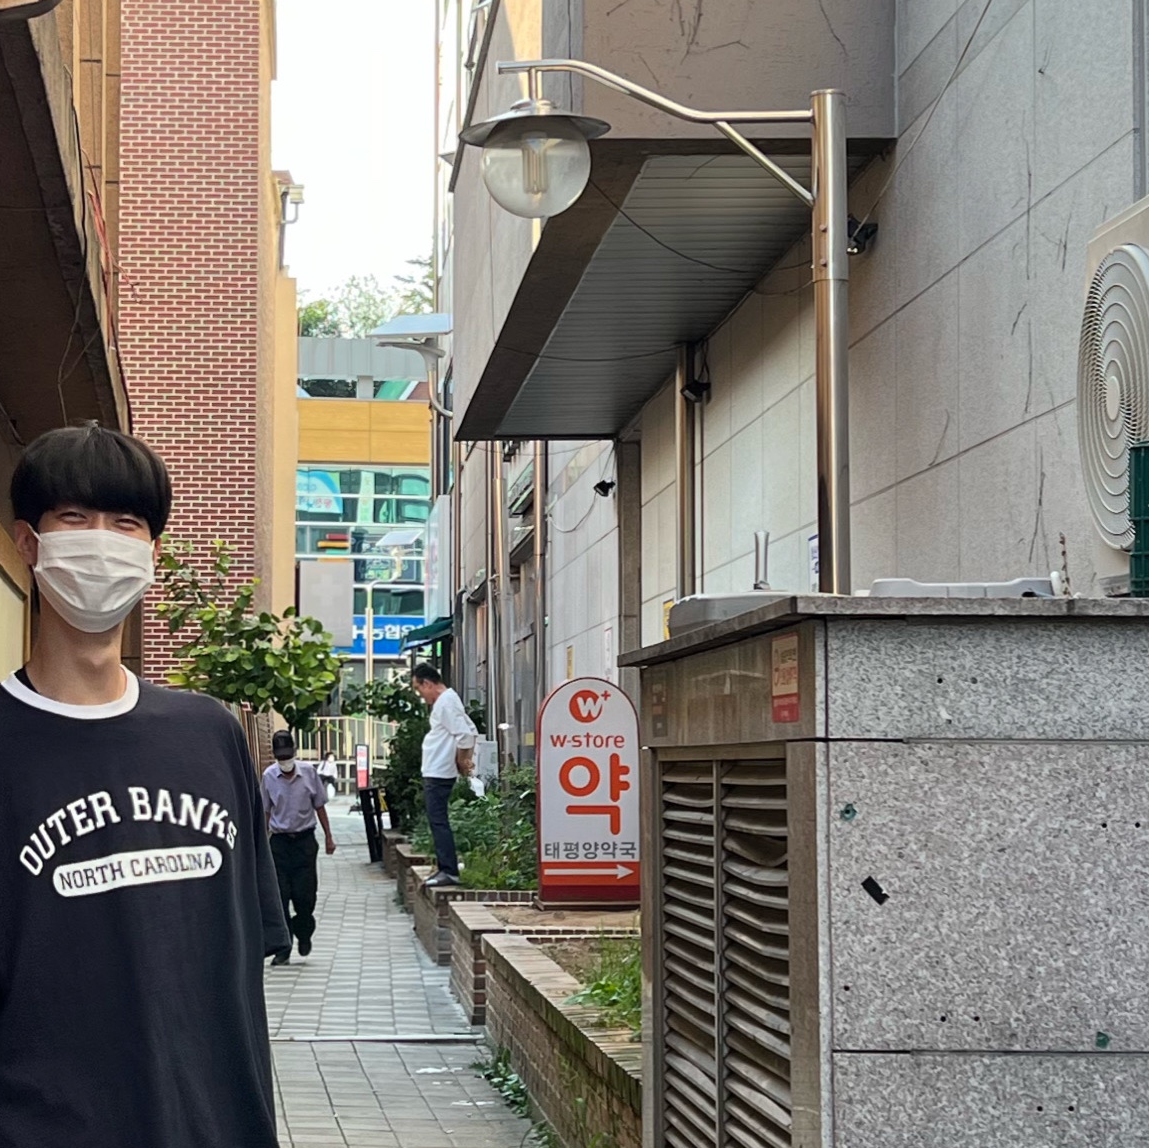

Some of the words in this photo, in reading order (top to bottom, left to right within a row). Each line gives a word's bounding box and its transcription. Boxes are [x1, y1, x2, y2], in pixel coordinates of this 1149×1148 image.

[558, 752, 631, 836] 약
[19, 790, 122, 876] OUTER
[128, 786, 238, 850] BANKS
[544, 841, 637, 860] 태평양약국
[58, 860, 126, 891] NORTH
[131, 852, 215, 878] CAROLINA
